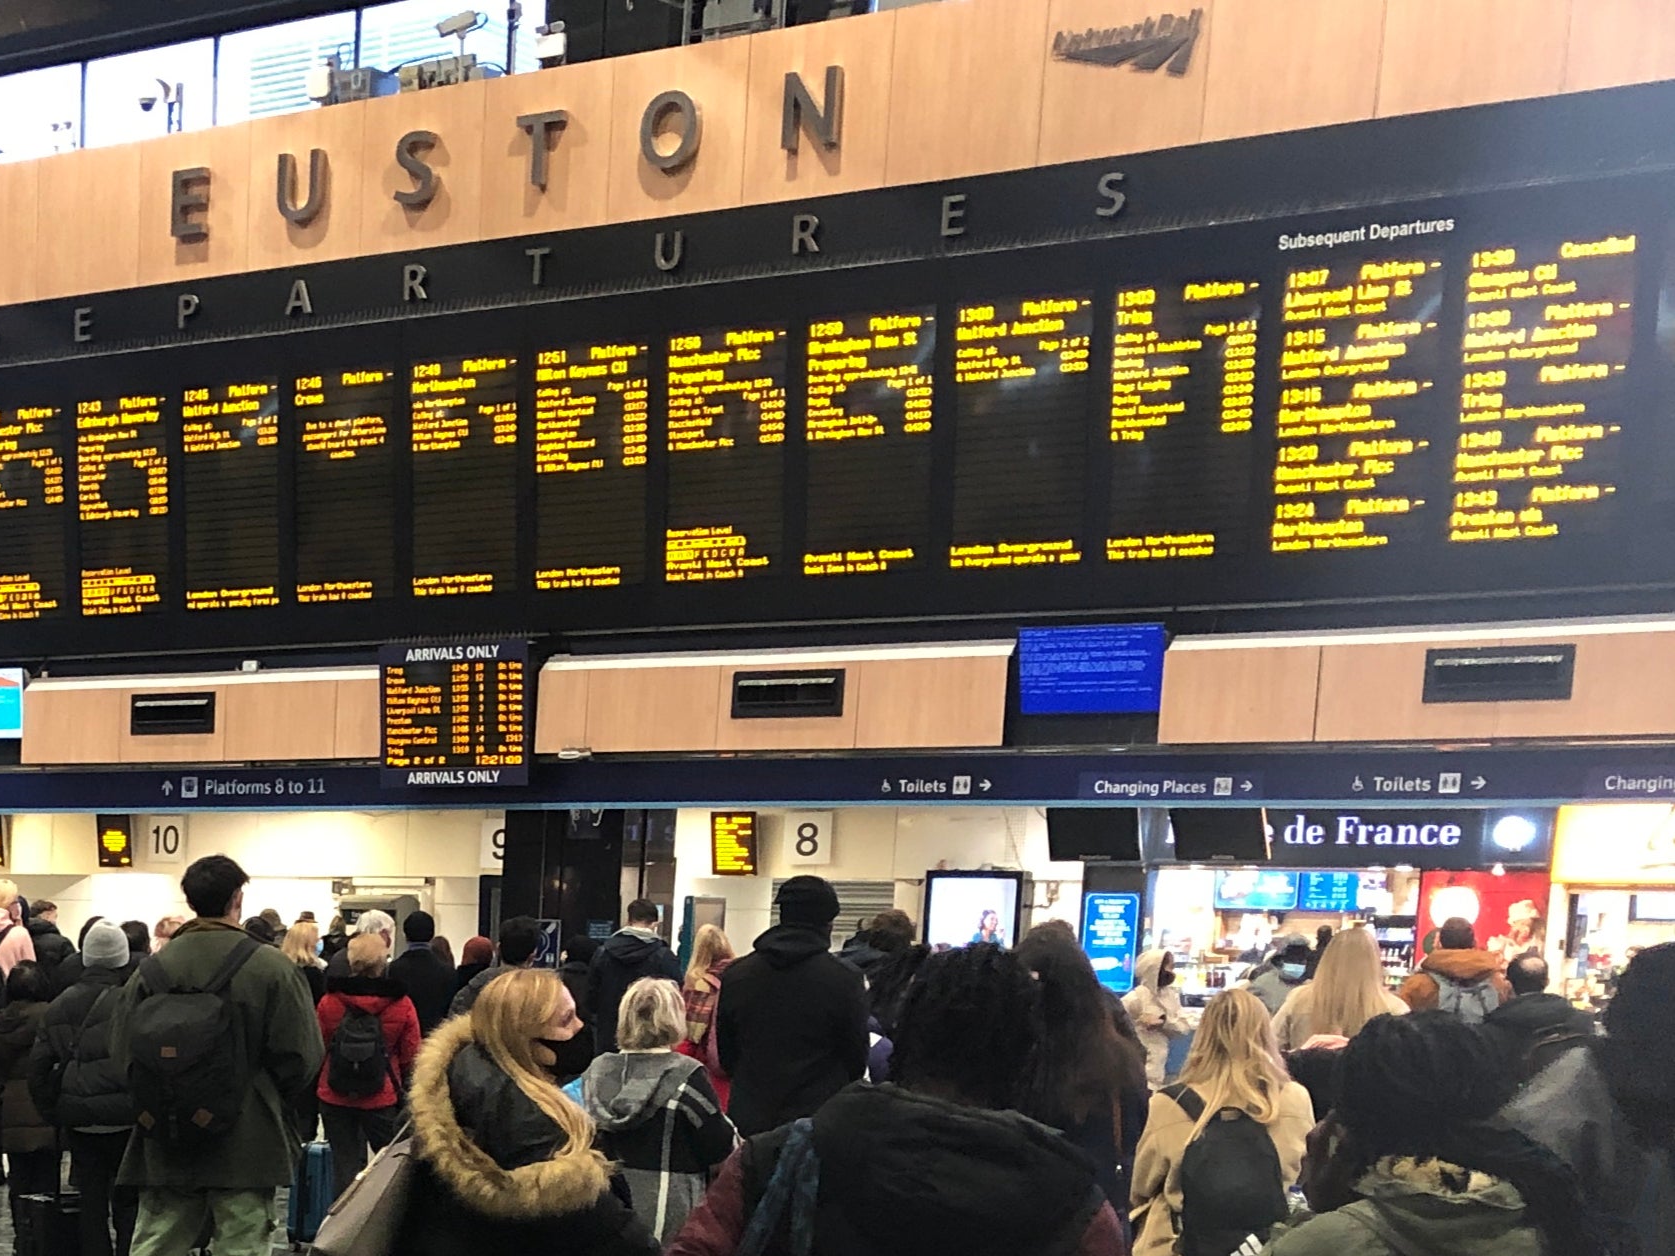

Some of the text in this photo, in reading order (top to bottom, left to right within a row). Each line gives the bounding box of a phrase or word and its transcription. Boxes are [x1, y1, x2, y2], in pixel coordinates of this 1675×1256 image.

[171, 65, 845, 239] EUSTON
[1279, 218, 1455, 250] Subsequent Departures
[1289, 261, 1426, 288] 13:07 Platform
[1117, 282, 1246, 307] 13:03 Platform
[1285, 280, 1413, 308] Liverpool Lime St
[959, 301, 1078, 323] 13:00 Platform
[1116, 310, 1153, 326] Tring
[810, 316, 922, 337] 12:59 Platform
[956, 318, 1065, 341] Watford Junction
[1286, 321, 1422, 346] 13:15 Platform
[1463, 322, 1598, 348] Watford Junction
[808, 332, 918, 355] Birmingham New St
[538, 345, 637, 365] 12:51 Platform
[669, 347, 762, 368] Manchester Picc
[808, 356, 868, 372] Preparing
[1281, 341, 1406, 367] Watford Junction
[414, 358, 507, 378] 12:49 Platform
[669, 370, 724, 384] Preparing
[1540, 363, 1609, 383] Platform
[296, 371, 384, 390] 12:46 Platform
[412, 377, 477, 394] Northampton
[184, 385, 268, 402] 12:45 Platform
[295, 393, 324, 407] Crewe
[1282, 380, 1418, 405] 13:15 Platform
[1461, 391, 1504, 408] Tring
[78, 396, 157, 414] 12:43 Platform
[183, 400, 260, 418] Watford Junction
[1278, 402, 1372, 424] Northampton
[77, 411, 160, 429] Edinburgh Waverley
[1460, 424, 1604, 449] 13:40 Platform
[1279, 439, 1414, 462] 13:20 Platform
[1456, 445, 1584, 469] Manchester Picc
[1275, 459, 1395, 480] Manchester Picc
[1456, 485, 1600, 508] 13:43 Platform
[1276, 498, 1410, 519] 13:24 Platform
[1273, 519, 1364, 538] Northampton
[950, 539, 1073, 557] London Overground
[1106, 533, 1215, 549] London Northwestern
[667, 556, 770, 571] Avanti West Coast
[804, 548, 915, 564] Avanti West Coast
[536, 566, 621, 579] London Northwestern
[405, 644, 500, 662] ARRIVALS ONLY
[386, 757, 411, 767] Page
[423, 756, 435, 766] of
[204, 777, 326, 795] Platforms 8 to 11
[407, 770, 500, 785] ARRIVALS ONLY
[898, 779, 947, 794] Toilets
[1373, 777, 1432, 793] Toilets
[1604, 776, 1675, 792] Changin
[1093, 779, 1207, 797] Changing Places
[152, 825, 180, 855] 10
[795, 822, 819, 857] 8
[1284, 814, 1325, 845] de
[1335, 815, 1462, 846] France
[492, 828, 505, 861] 9
